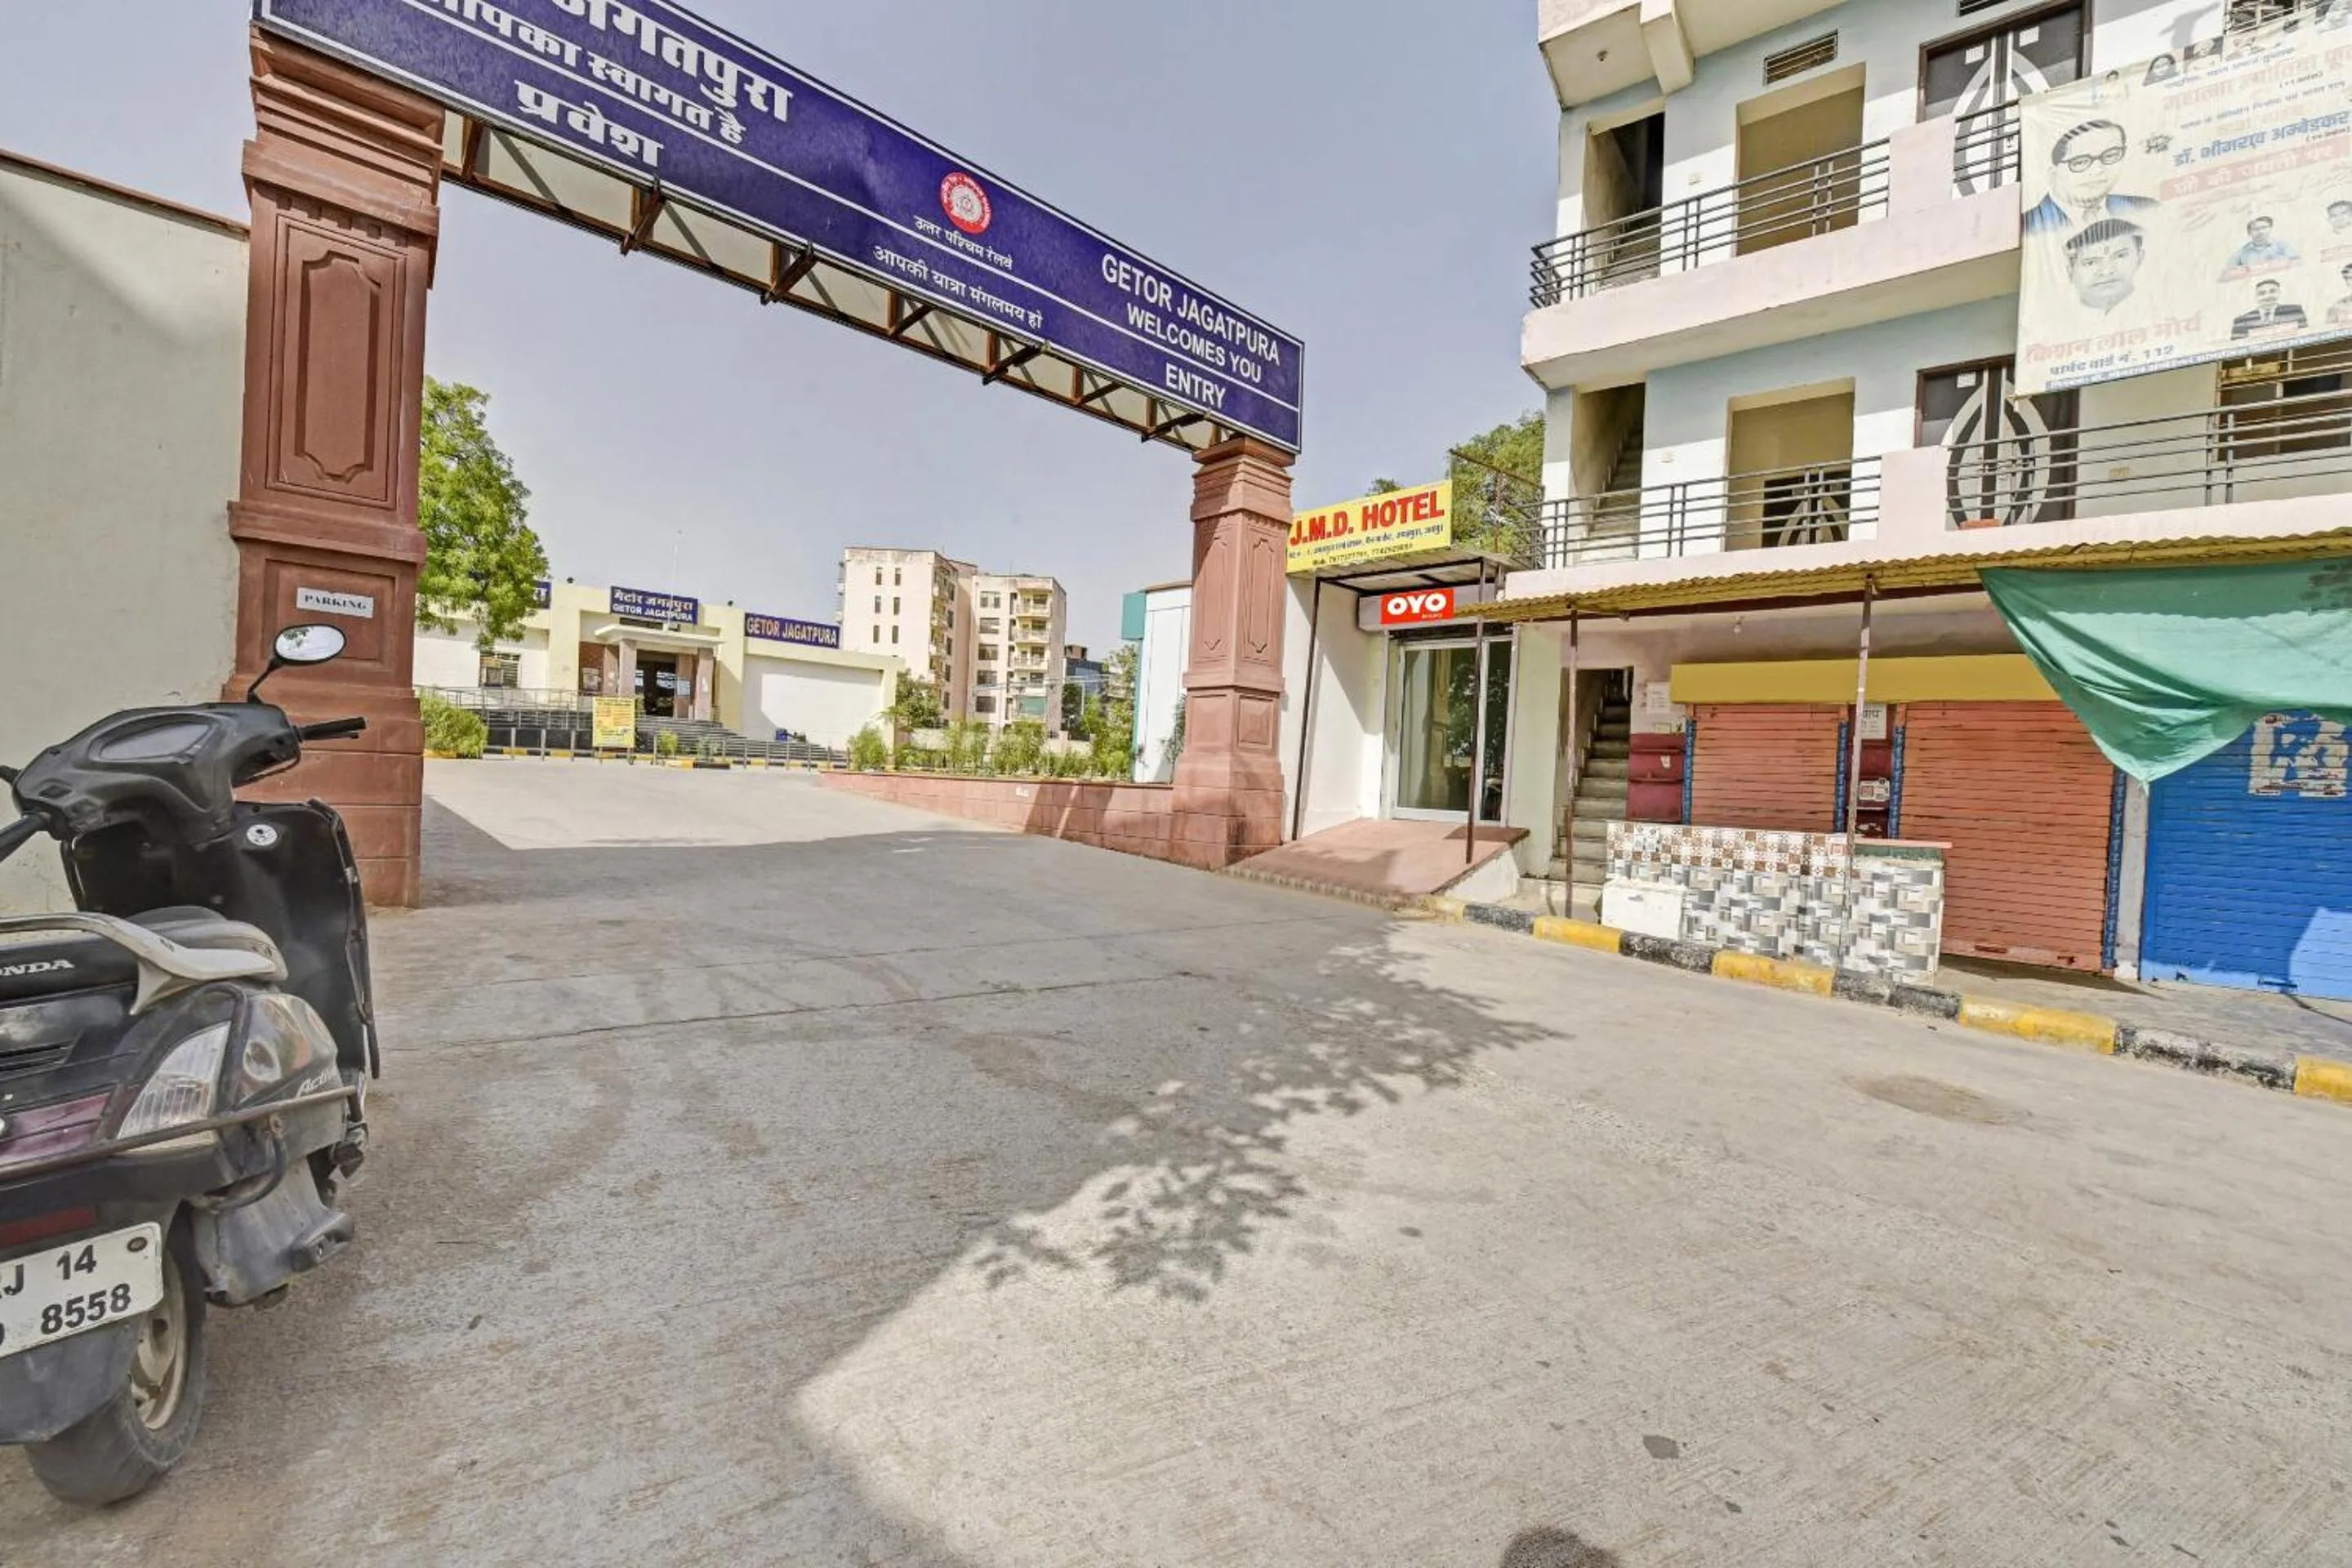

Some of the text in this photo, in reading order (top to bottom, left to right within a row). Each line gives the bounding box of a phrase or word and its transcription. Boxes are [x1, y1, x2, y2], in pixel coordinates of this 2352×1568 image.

[514, 80, 664, 167] प्रवेश
[587, 51, 714, 131] स्वागत
[714, 106, 746, 144] है
[873, 246, 1043, 328] आपकी यात्रा मंगलमय हो
[1102, 253, 1281, 366] GETOR JAGATPURA
[1127, 302, 1262, 384] WELCOMES YOU
[2143, 344, 2174, 359] 112
[1165, 363, 1226, 409] ENTRY
[1290, 490, 1445, 546] J.M.D. HOTEL
[612, 603, 693, 621] GETOR JAGATPURA
[1388, 593, 1446, 616] OYO
[746, 617, 837, 645] GETOR JAGATPURA
[0, 959, 75, 976] NDA
[0, 1244, 96, 1298] J 14
[41, 1283, 131, 1334] 8558
